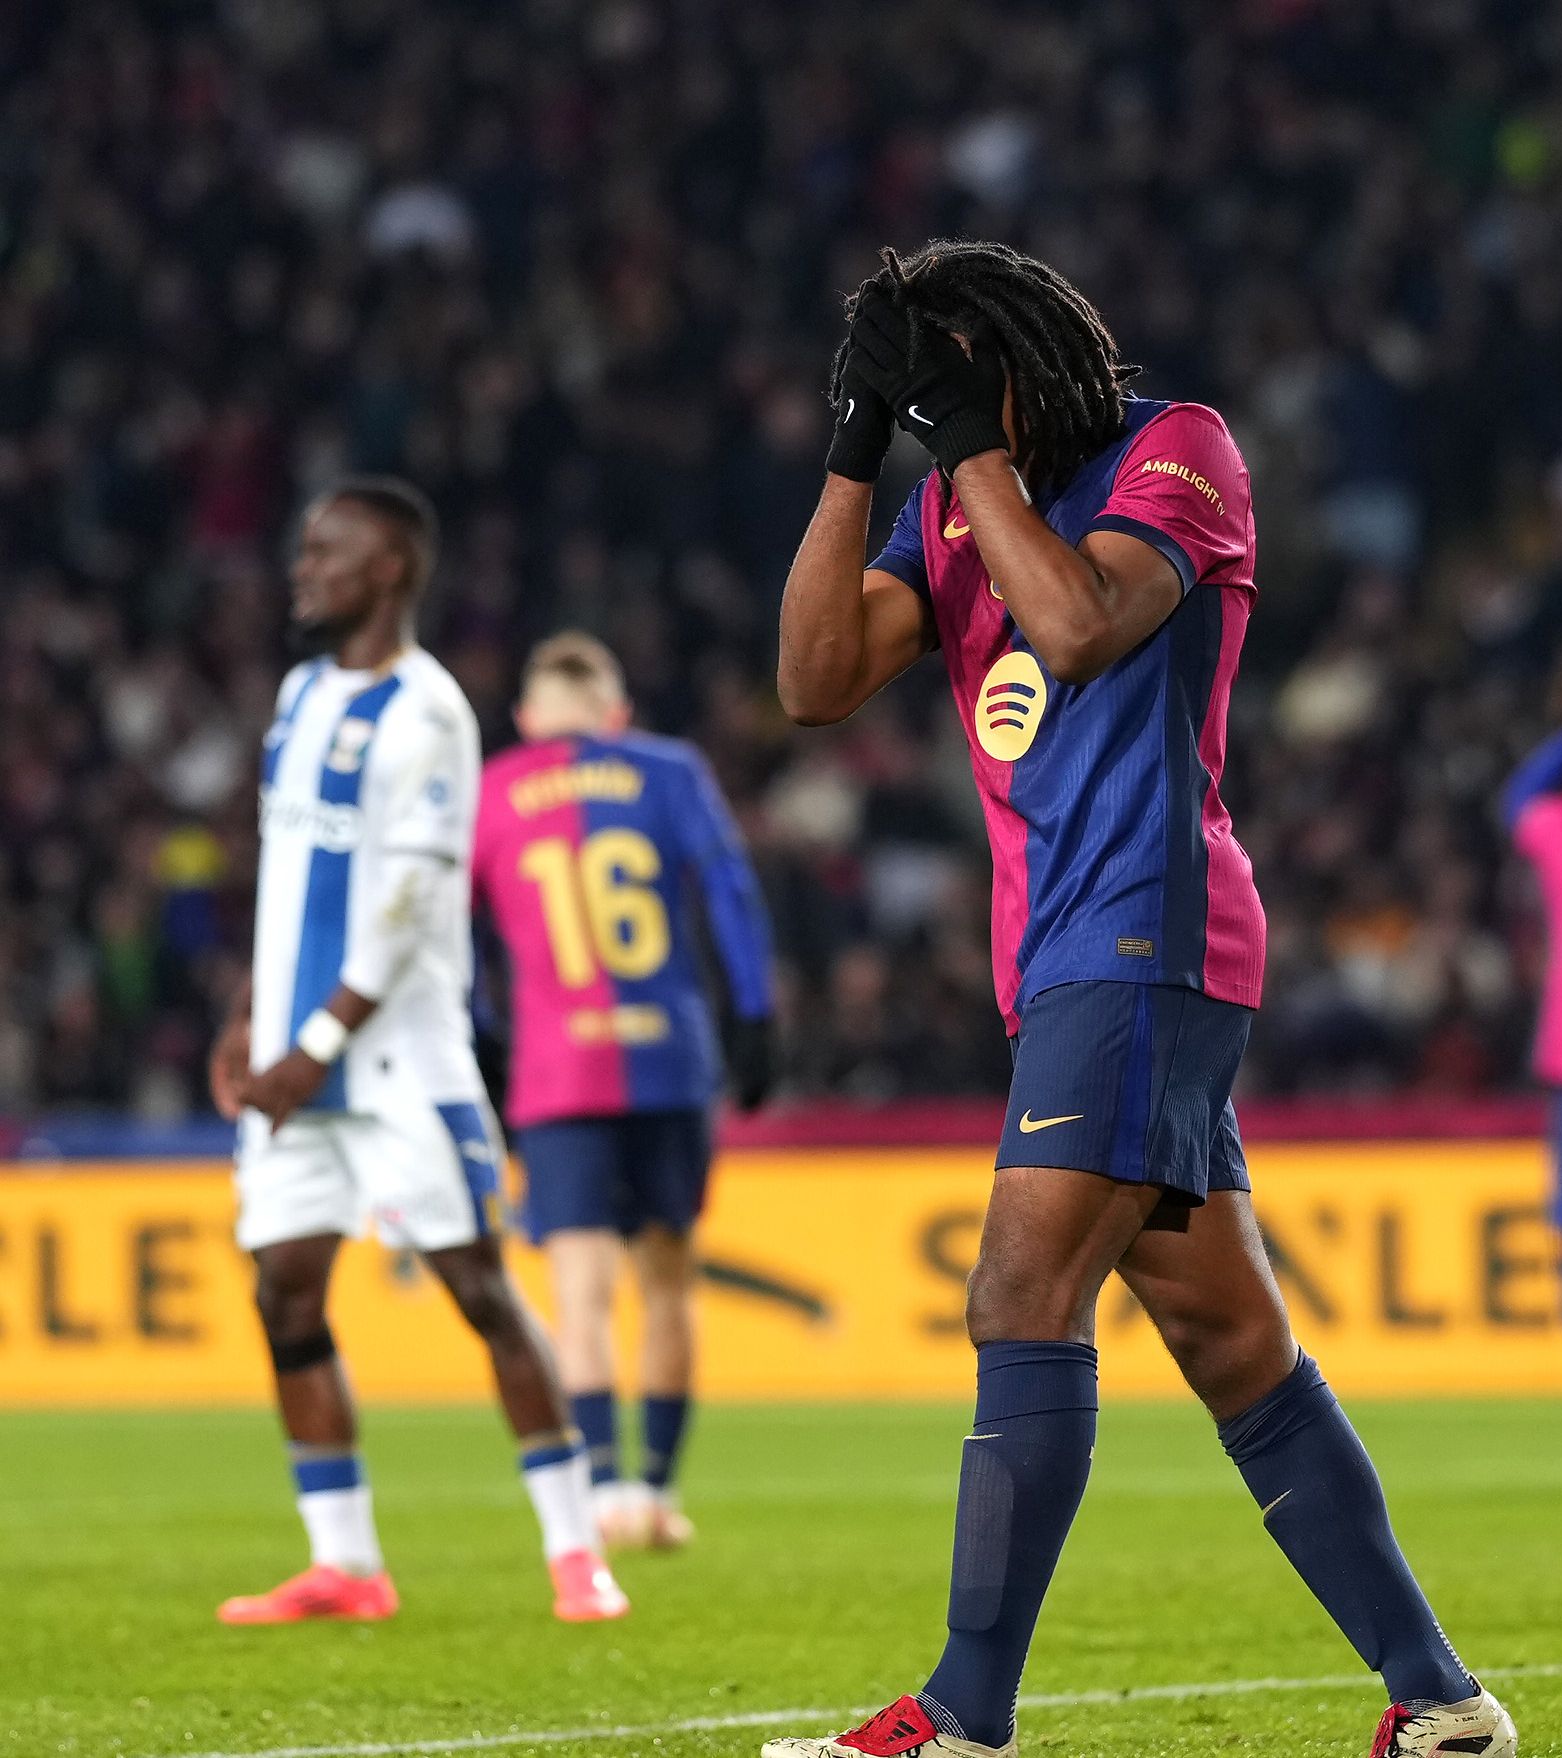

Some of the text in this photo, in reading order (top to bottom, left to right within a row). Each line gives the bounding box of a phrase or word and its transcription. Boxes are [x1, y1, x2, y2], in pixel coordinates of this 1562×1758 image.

[1141, 460, 1226, 517] AMBILIGHT tv
[517, 826, 671, 990] 16
